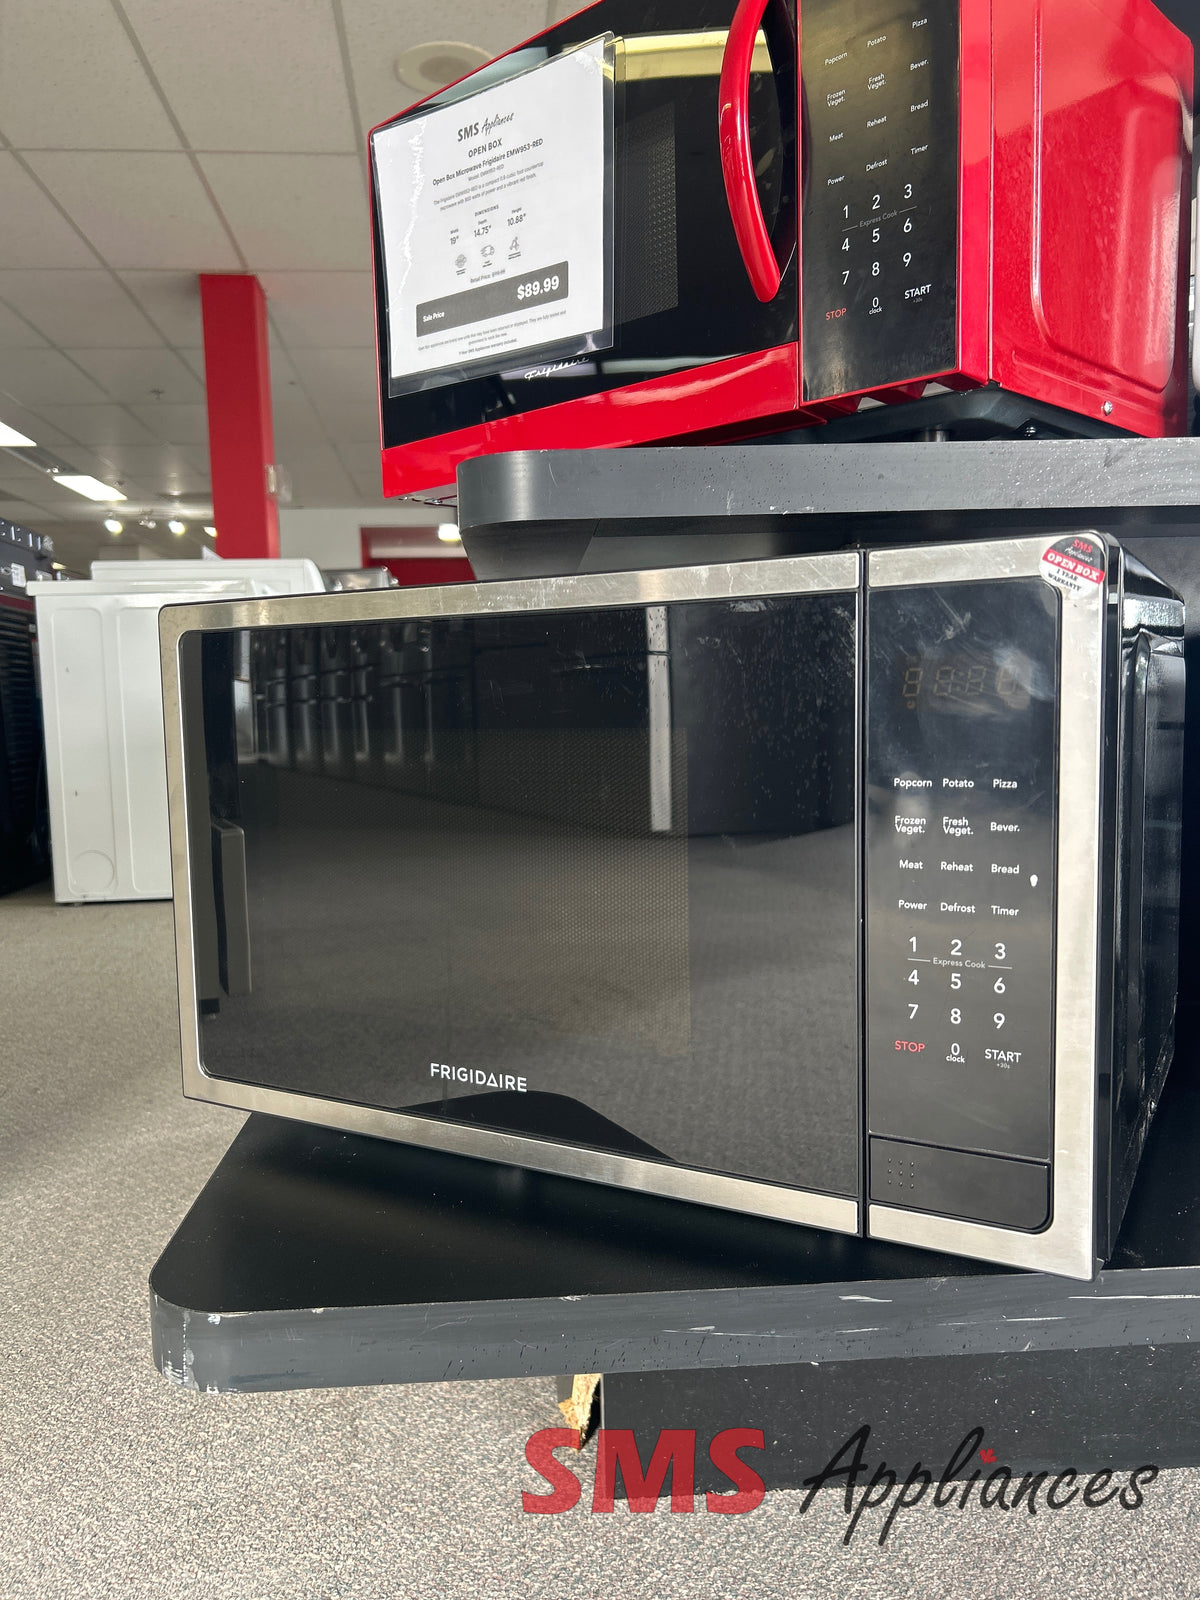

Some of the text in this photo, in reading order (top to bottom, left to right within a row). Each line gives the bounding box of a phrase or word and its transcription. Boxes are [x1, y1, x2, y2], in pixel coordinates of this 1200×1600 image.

[912, 18, 928, 29] Pizza
[867, 35, 887, 47] Potato
[824, 52, 848, 66] Popcorn
[910, 59, 929, 71] Bever.
[868, 73, 885, 83] Fresh
[867, 79, 887, 91] Veget.
[826, 89, 846, 100] Frozen
[827, 96, 845, 107] Veget.
[910, 100, 929, 112] Bread
[457, 112, 515, 142] SMS Appliances
[866, 116, 887, 128] Reheat
[829, 133, 843, 143] Meat
[468, 138, 503, 158] OPEN BOX
[910, 144, 928, 155] Timer
[432, 138, 544, 186] Open Box Microwave Frigidaire EMW953-RED
[866, 159, 888, 172] Defrost
[827, 175, 845, 186] Power
[904, 184, 912, 199] 3
[872, 194, 881, 210] 2
[843, 205, 849, 219] 1
[859, 210, 898, 228] Express Cook
[903, 218, 912, 233] 6
[872, 228, 880, 243] 5
[842, 237, 850, 252] 4
[903, 252, 912, 267] 9
[872, 261, 880, 277] 8
[842, 271, 850, 286] 7
[517, 275, 560, 300] $89.99
[904, 284, 932, 299] START
[872, 297, 879, 308] 0
[825, 308, 847, 321] STOP
[869, 306, 882, 315] clock
[423, 311, 445, 323] Sale Price
[524, 357, 590, 381] Frigidaire
[1073, 539, 1093, 553] SMS
[1047, 552, 1100, 581] OPEN BOX
[1061, 570, 1078, 581] YEAR
[1048, 572, 1081, 592] WARRANTY
[893, 778, 933, 790] Popcorn
[942, 778, 974, 788] Potato
[992, 779, 1018, 789] Pizza
[895, 815, 926, 825] Frozen
[942, 816, 969, 826] Fresh
[895, 824, 925, 835] Veget.
[943, 825, 974, 836] Veget.
[990, 822, 1020, 832] Bever.
[899, 859, 923, 870] Meat
[941, 861, 973, 872] Reheat
[991, 864, 1019, 874] Bread
[898, 900, 927, 910] Power
[940, 902, 976, 913] Defrost
[991, 905, 1019, 916] Timer
[909, 936, 917, 952] 1
[950, 939, 962, 956] 2
[994, 942, 1006, 960] 3
[932, 957, 986, 969] Express Cook
[908, 969, 919, 985] 4
[950, 973, 961, 989] 5
[993, 977, 1006, 994] 6
[908, 1003, 919, 1019] 7
[950, 1008, 961, 1024] 8
[993, 1012, 1005, 1029] 9
[894, 1040, 926, 1052] STOP
[951, 1043, 960, 1055] 0
[946, 1054, 965, 1064] clock
[984, 1048, 1021, 1062] START
[430, 1062, 527, 1092] FRIGIDAIRE
